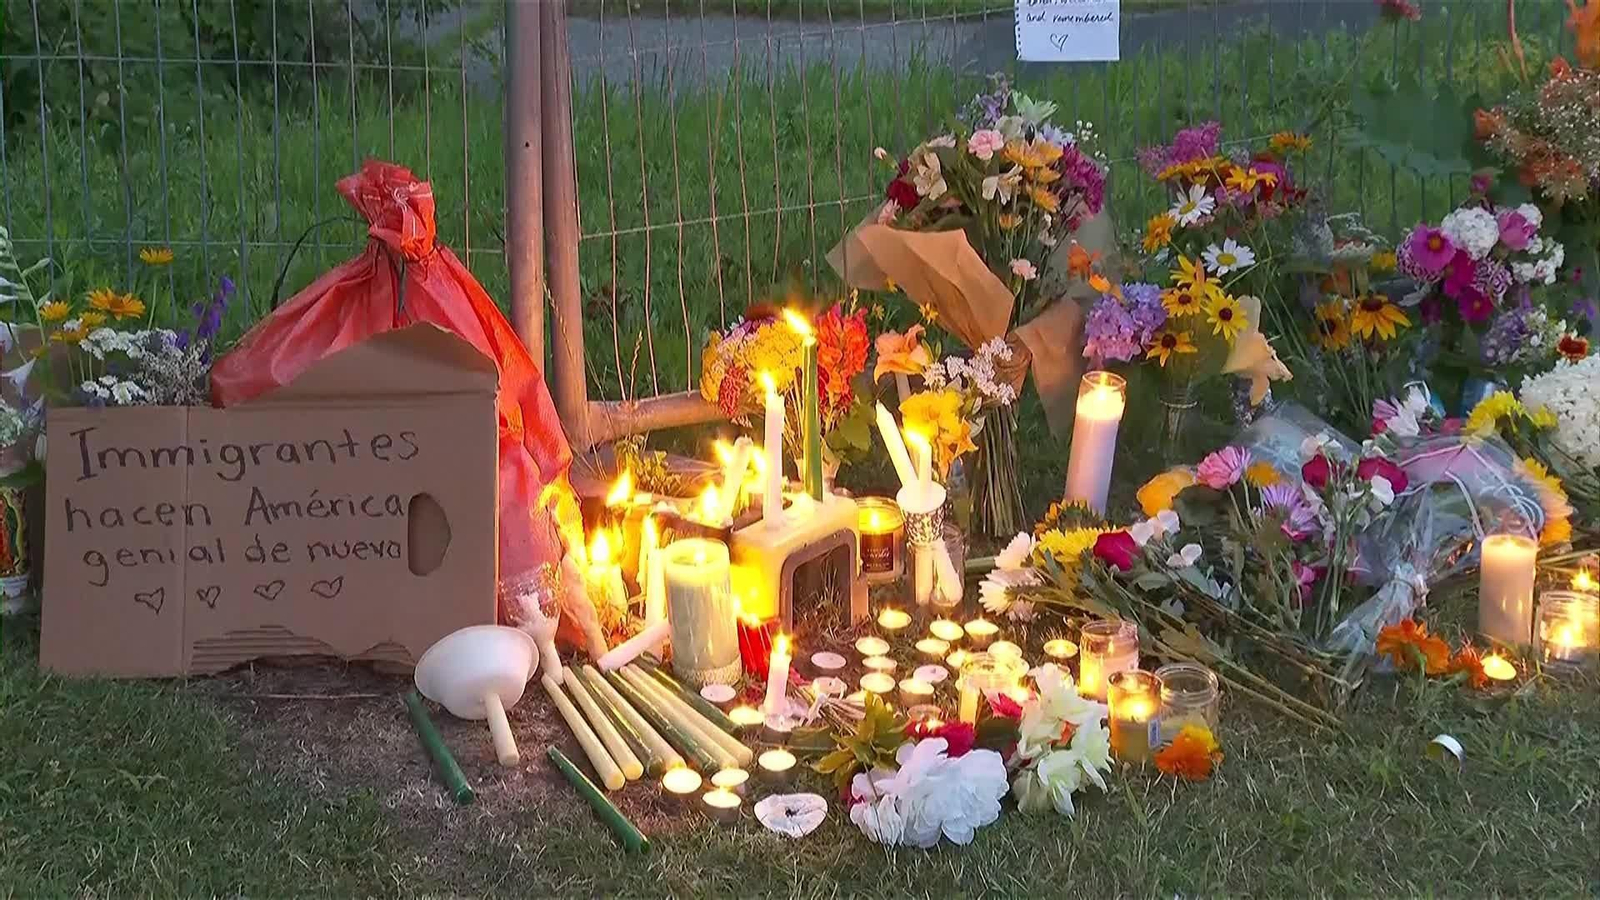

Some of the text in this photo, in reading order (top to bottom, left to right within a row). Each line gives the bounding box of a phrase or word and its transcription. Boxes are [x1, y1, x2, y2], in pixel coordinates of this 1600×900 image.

[1026, 10, 1113, 24] and remembered
[70, 427, 420, 481] Immigrantes
[64, 486, 406, 532] hacen América
[83, 538, 226, 587] genial
[245, 533, 291, 564] de
